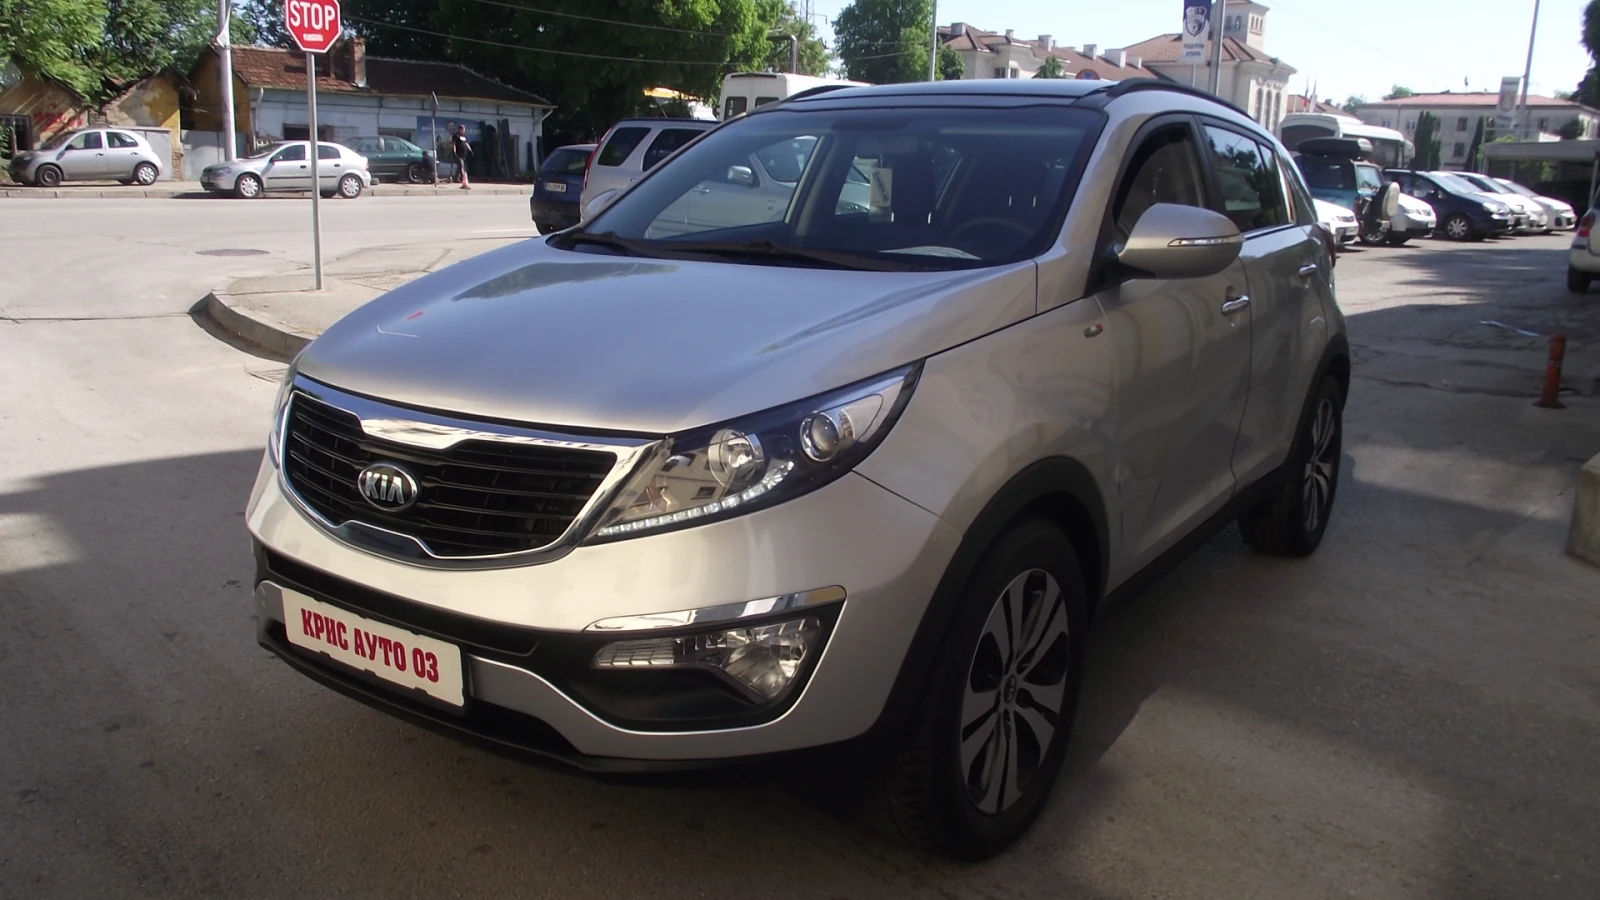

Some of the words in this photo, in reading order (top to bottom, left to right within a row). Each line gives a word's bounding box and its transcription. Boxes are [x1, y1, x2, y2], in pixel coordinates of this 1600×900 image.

[290, 0, 336, 31] STOP
[365, 471, 405, 504] KIA
[301, 608, 349, 651] КРИС
[354, 628, 407, 672] АУТО
[412, 647, 440, 683] 03
